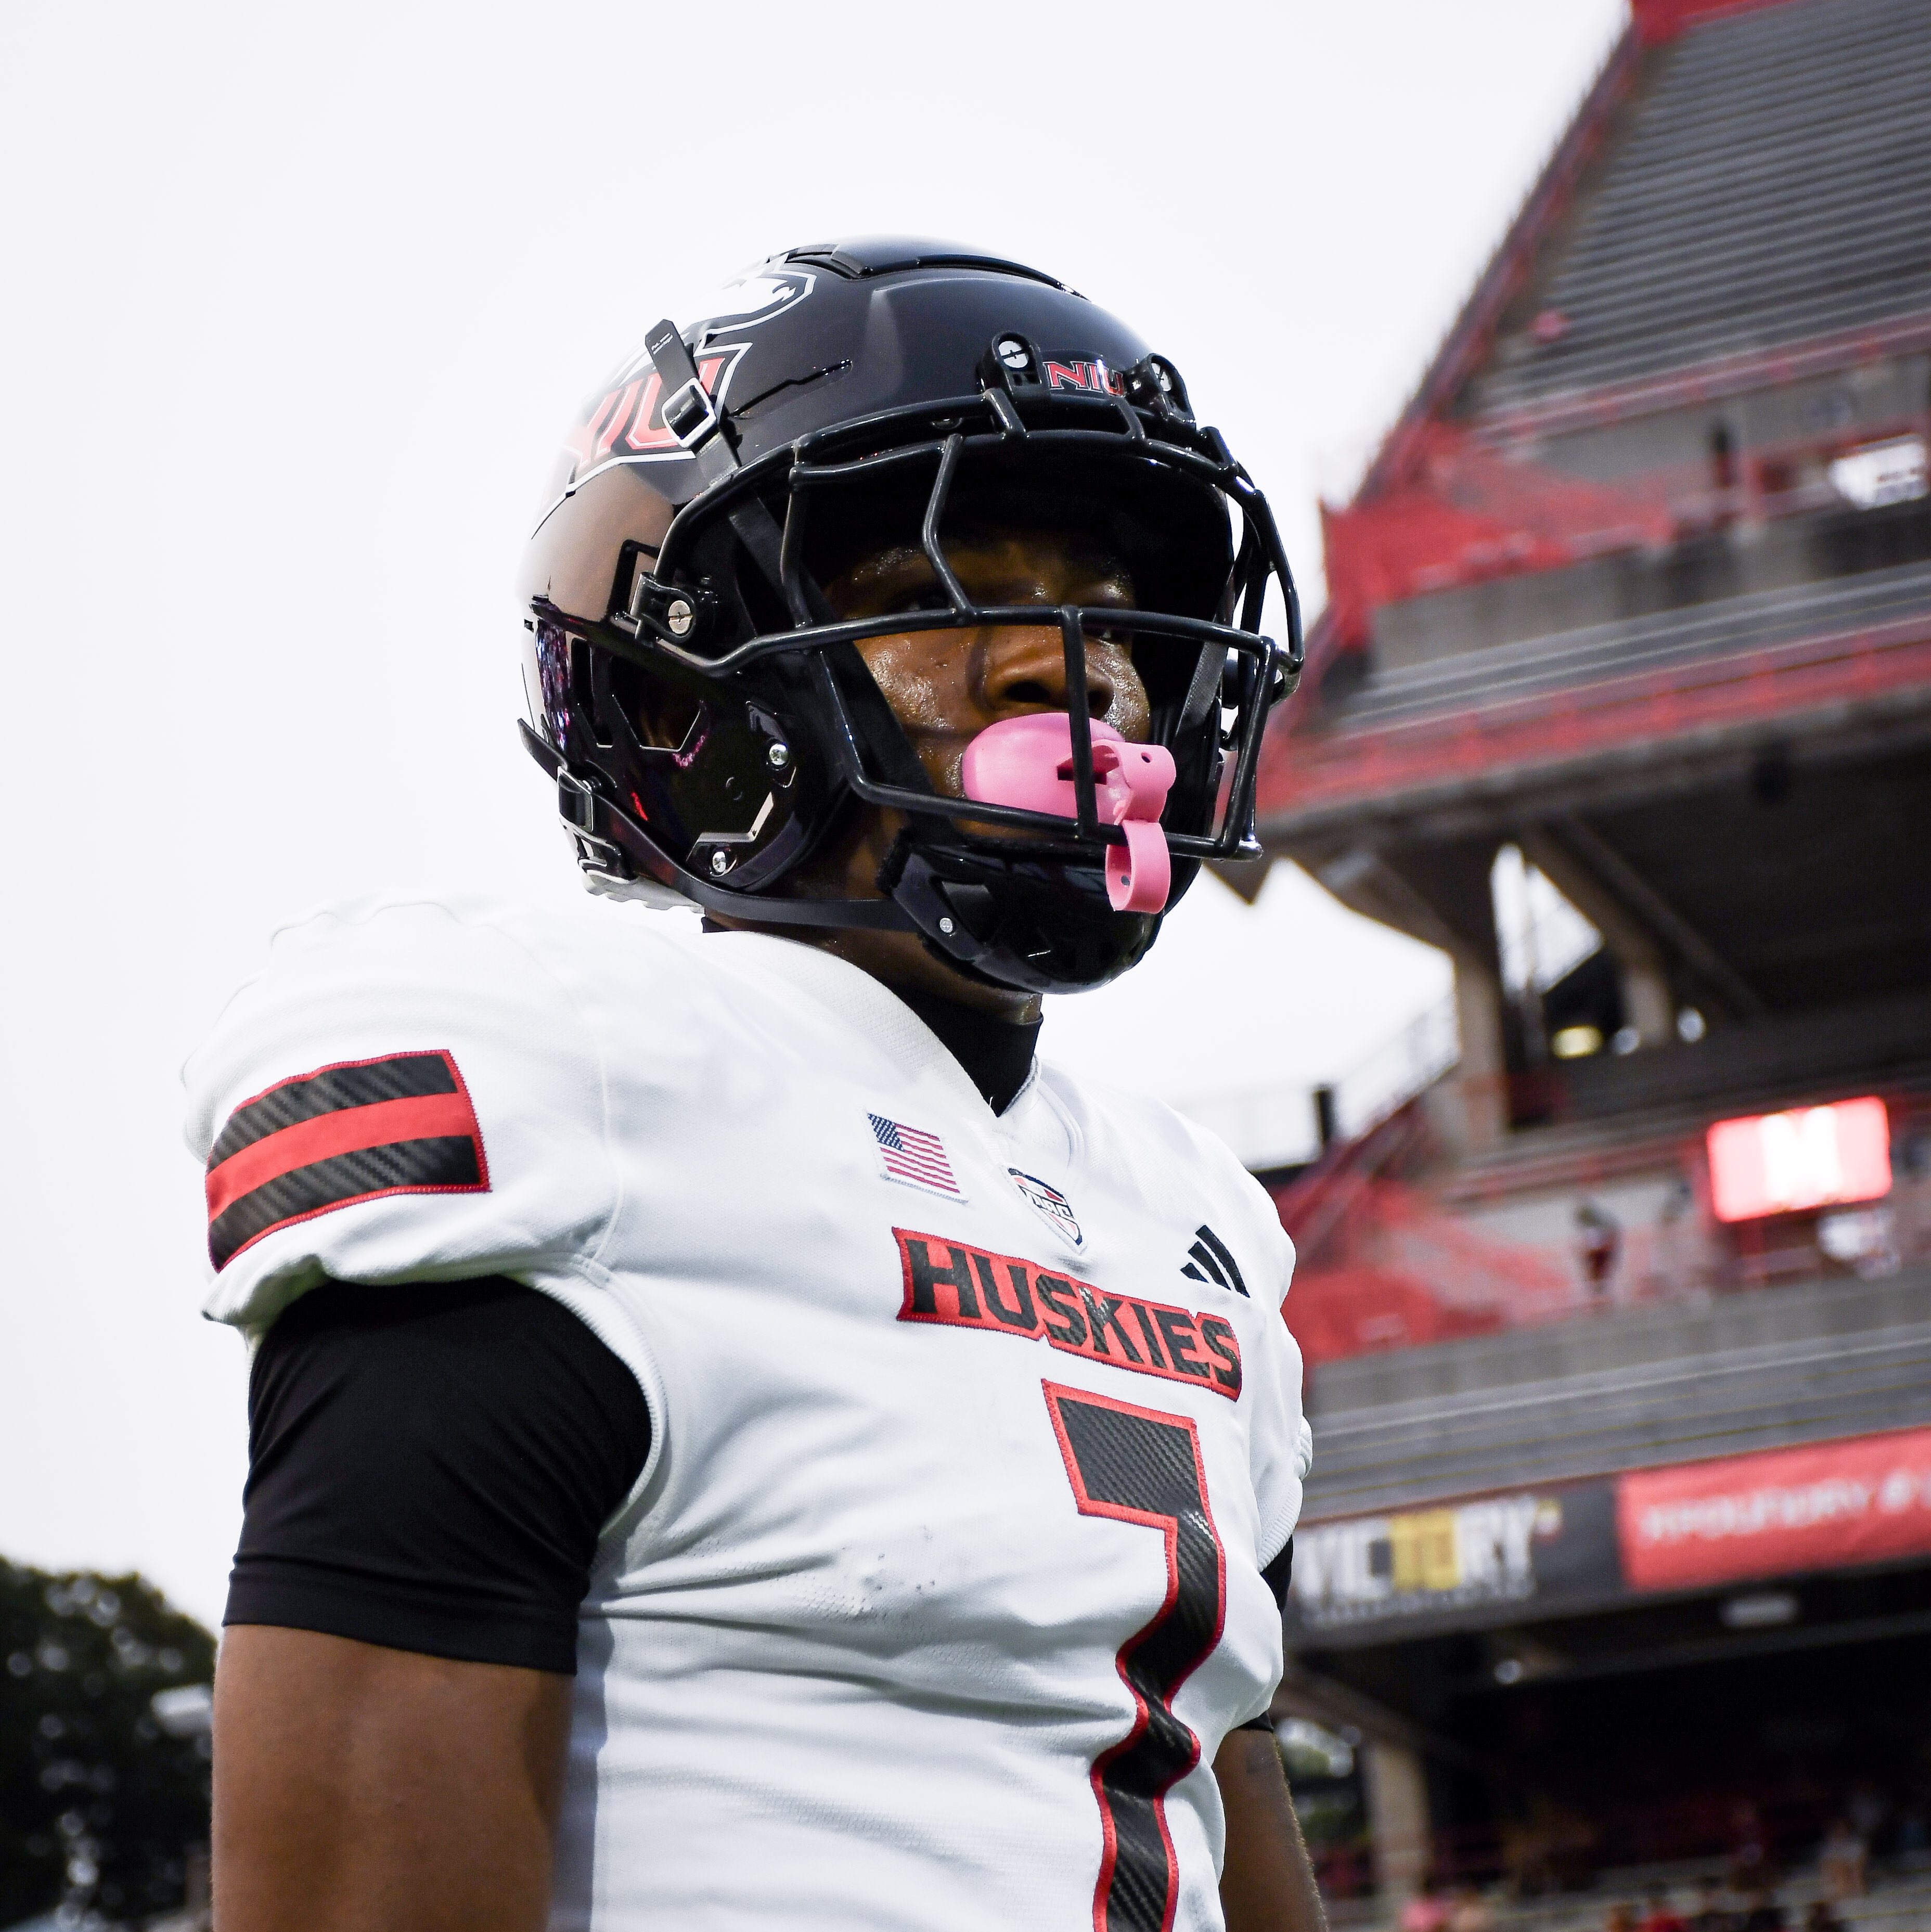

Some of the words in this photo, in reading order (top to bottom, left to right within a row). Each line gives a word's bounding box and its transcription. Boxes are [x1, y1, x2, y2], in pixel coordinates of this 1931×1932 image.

[1042, 361, 1123, 396] NIU
[894, 1229, 1242, 1400] HUSKIES
[1041, 1377, 1226, 1932] 7
